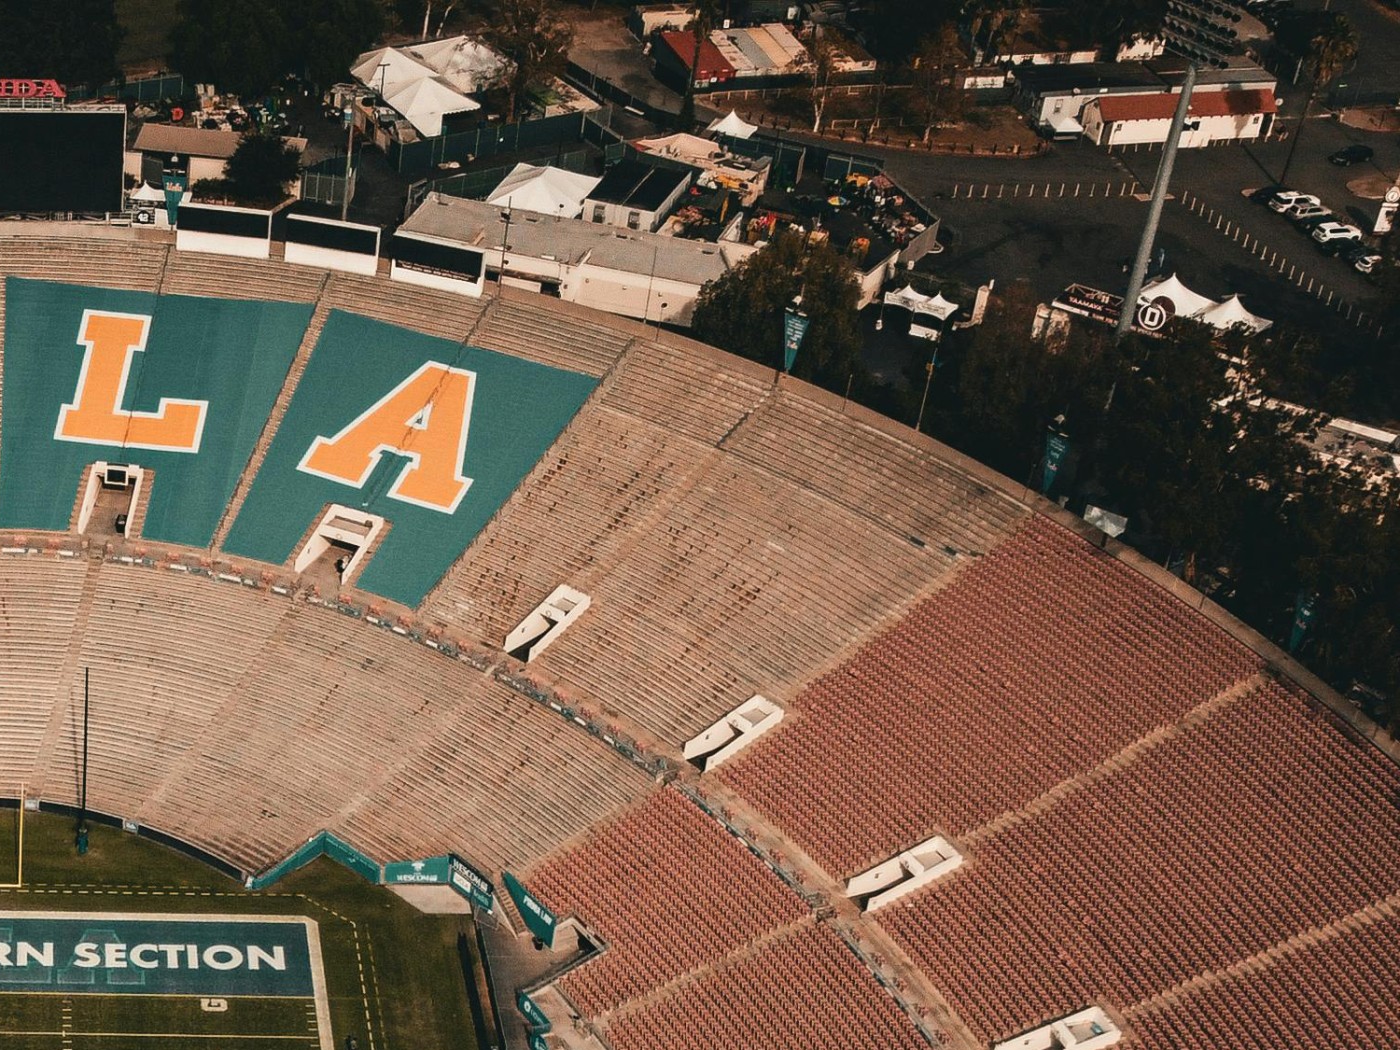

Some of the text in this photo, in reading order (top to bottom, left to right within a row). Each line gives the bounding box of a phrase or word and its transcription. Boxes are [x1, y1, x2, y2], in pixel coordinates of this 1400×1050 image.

[1144, 307, 1160, 326] D
[453, 858, 482, 885] WESCOM
[73, 942, 286, 970] SECTION
[200, 998, 228, 1012] G
